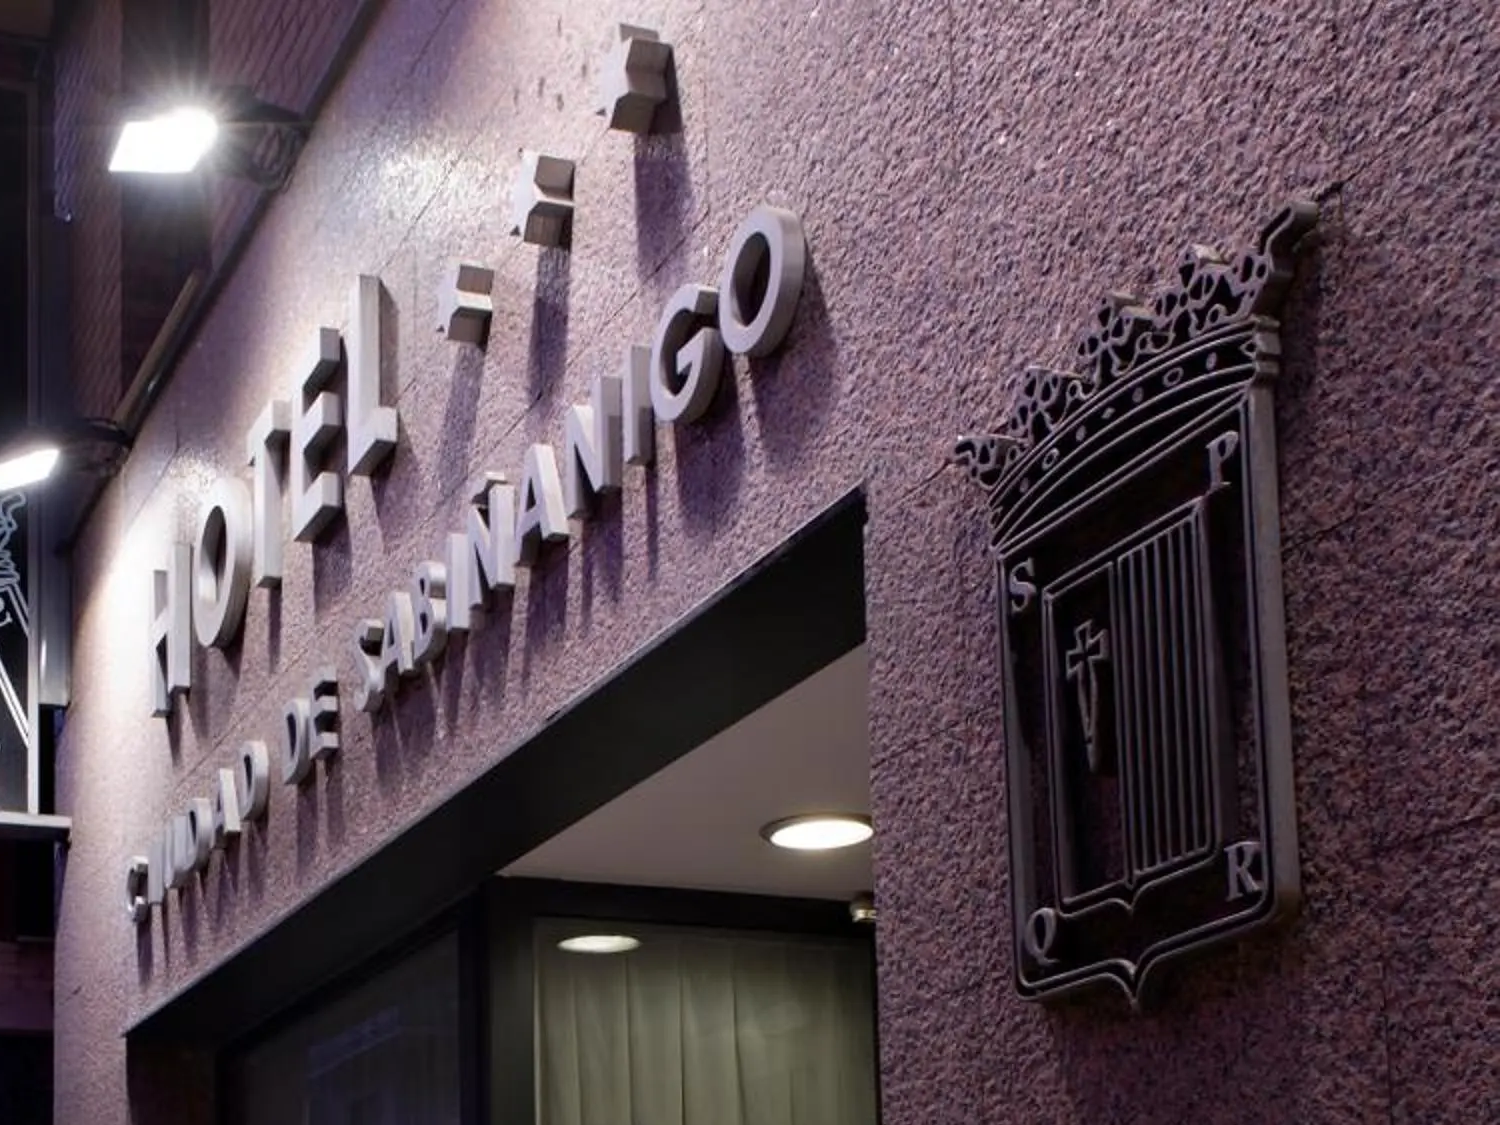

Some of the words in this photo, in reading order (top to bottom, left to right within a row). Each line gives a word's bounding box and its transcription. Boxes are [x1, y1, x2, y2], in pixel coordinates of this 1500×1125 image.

[149, 274, 398, 718] HOTEL
[122, 739, 270, 922] CIUDAD
[282, 666, 338, 784] DE
[353, 203, 805, 712] SABIÑANIGO
[1009, 557, 1037, 613] S
[1225, 841, 1264, 900] R
[1023, 907, 1061, 965] Q
